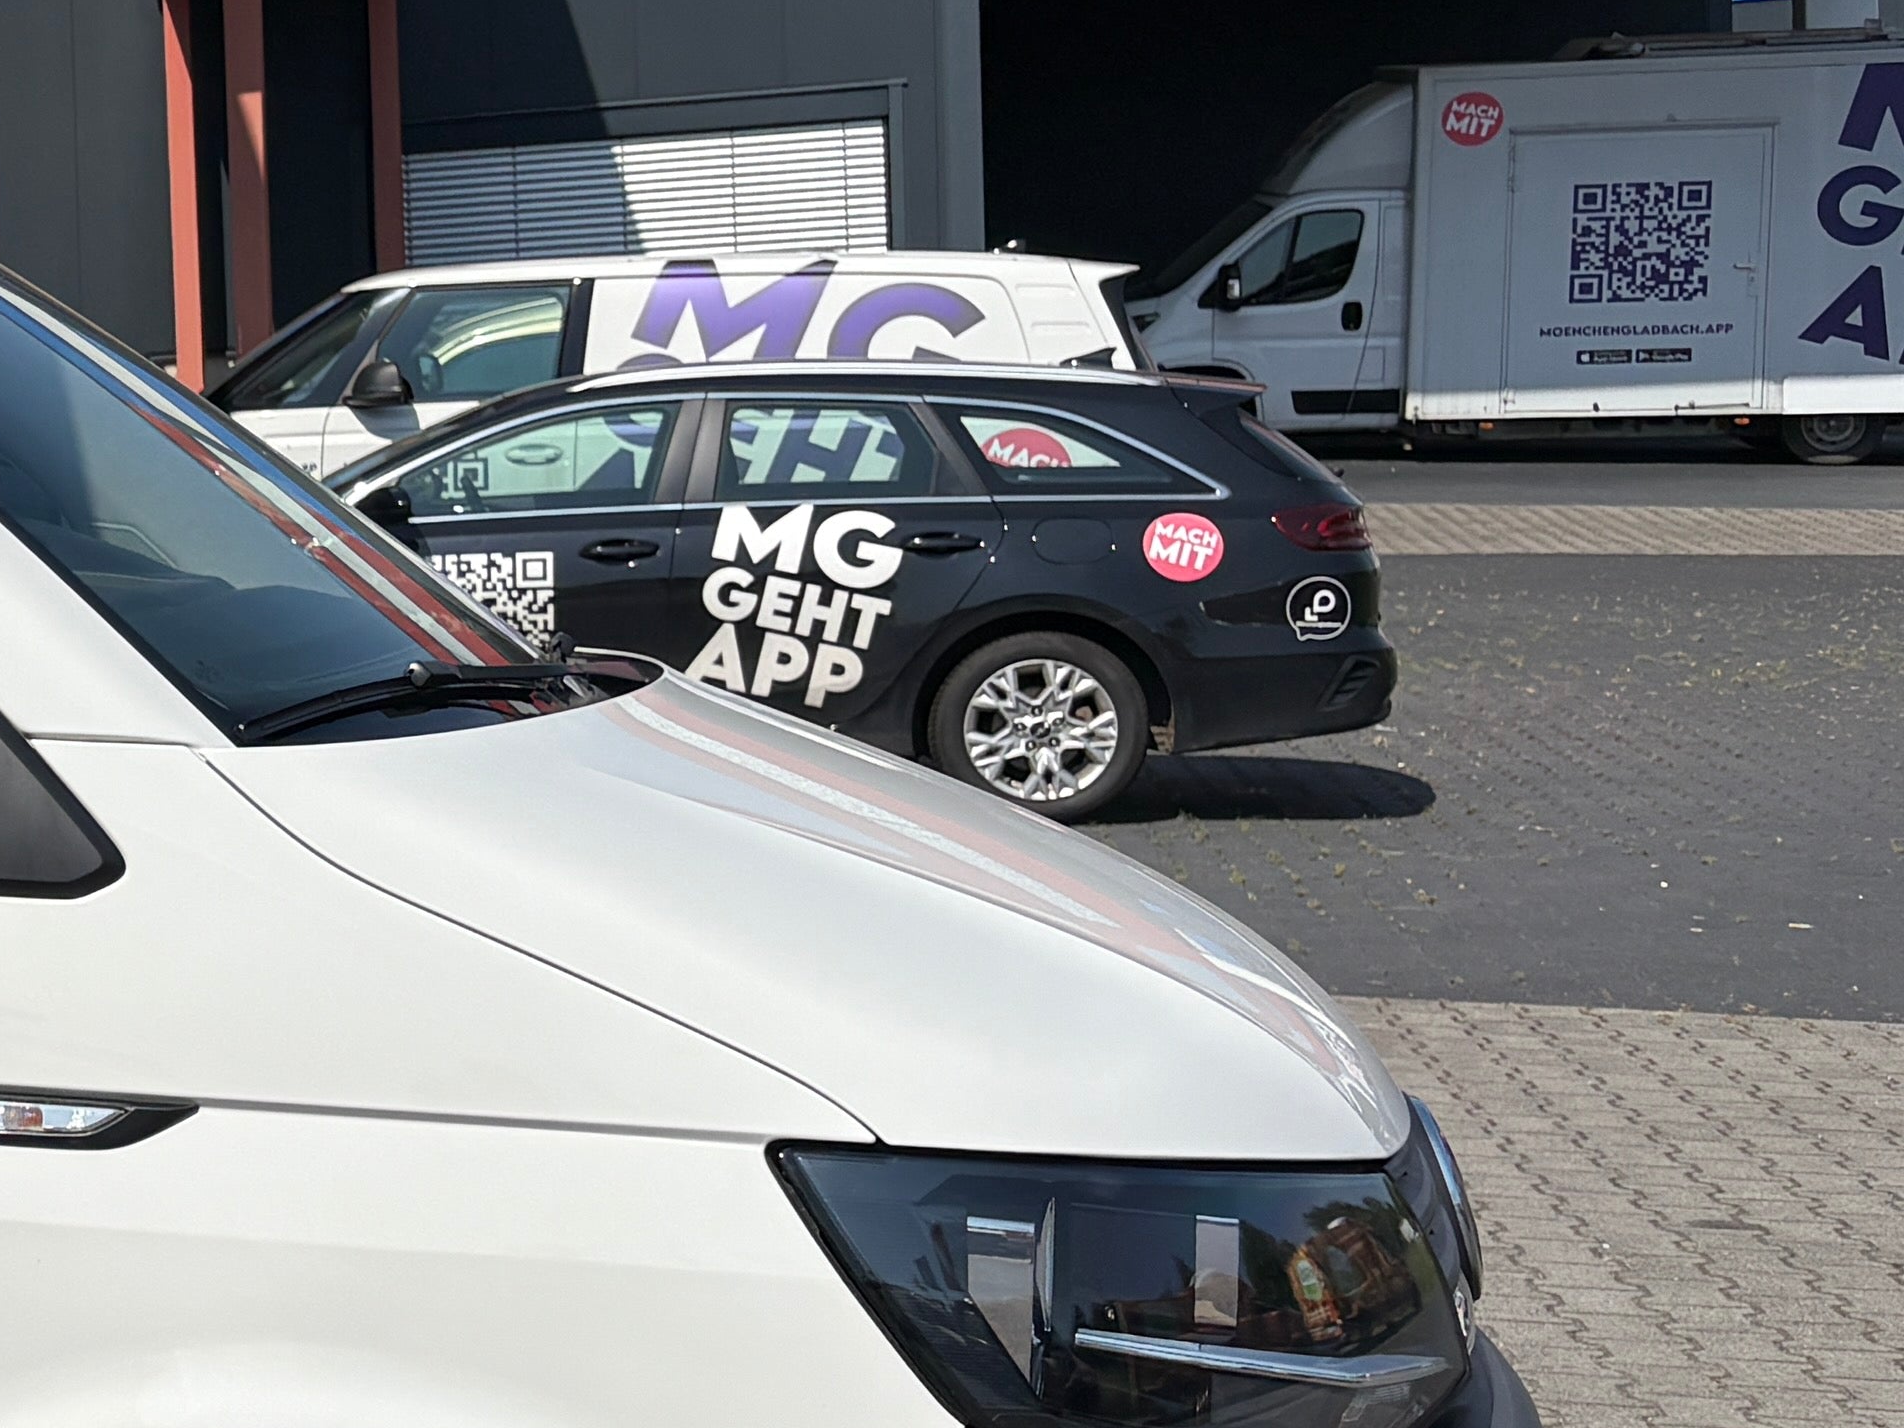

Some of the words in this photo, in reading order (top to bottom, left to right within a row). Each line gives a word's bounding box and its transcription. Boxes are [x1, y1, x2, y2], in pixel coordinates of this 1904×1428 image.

[1445, 112, 1496, 137] MIT
[1451, 101, 1499, 119] MACH
[1539, 323, 1733, 338] MOENCHENGLADBACH.APP
[711, 501, 904, 588] MG
[1154, 520, 1218, 549] MACH
[1149, 535, 1214, 571] MIT
[702, 566, 892, 650] GEHT
[684, 622, 863, 708] APP
